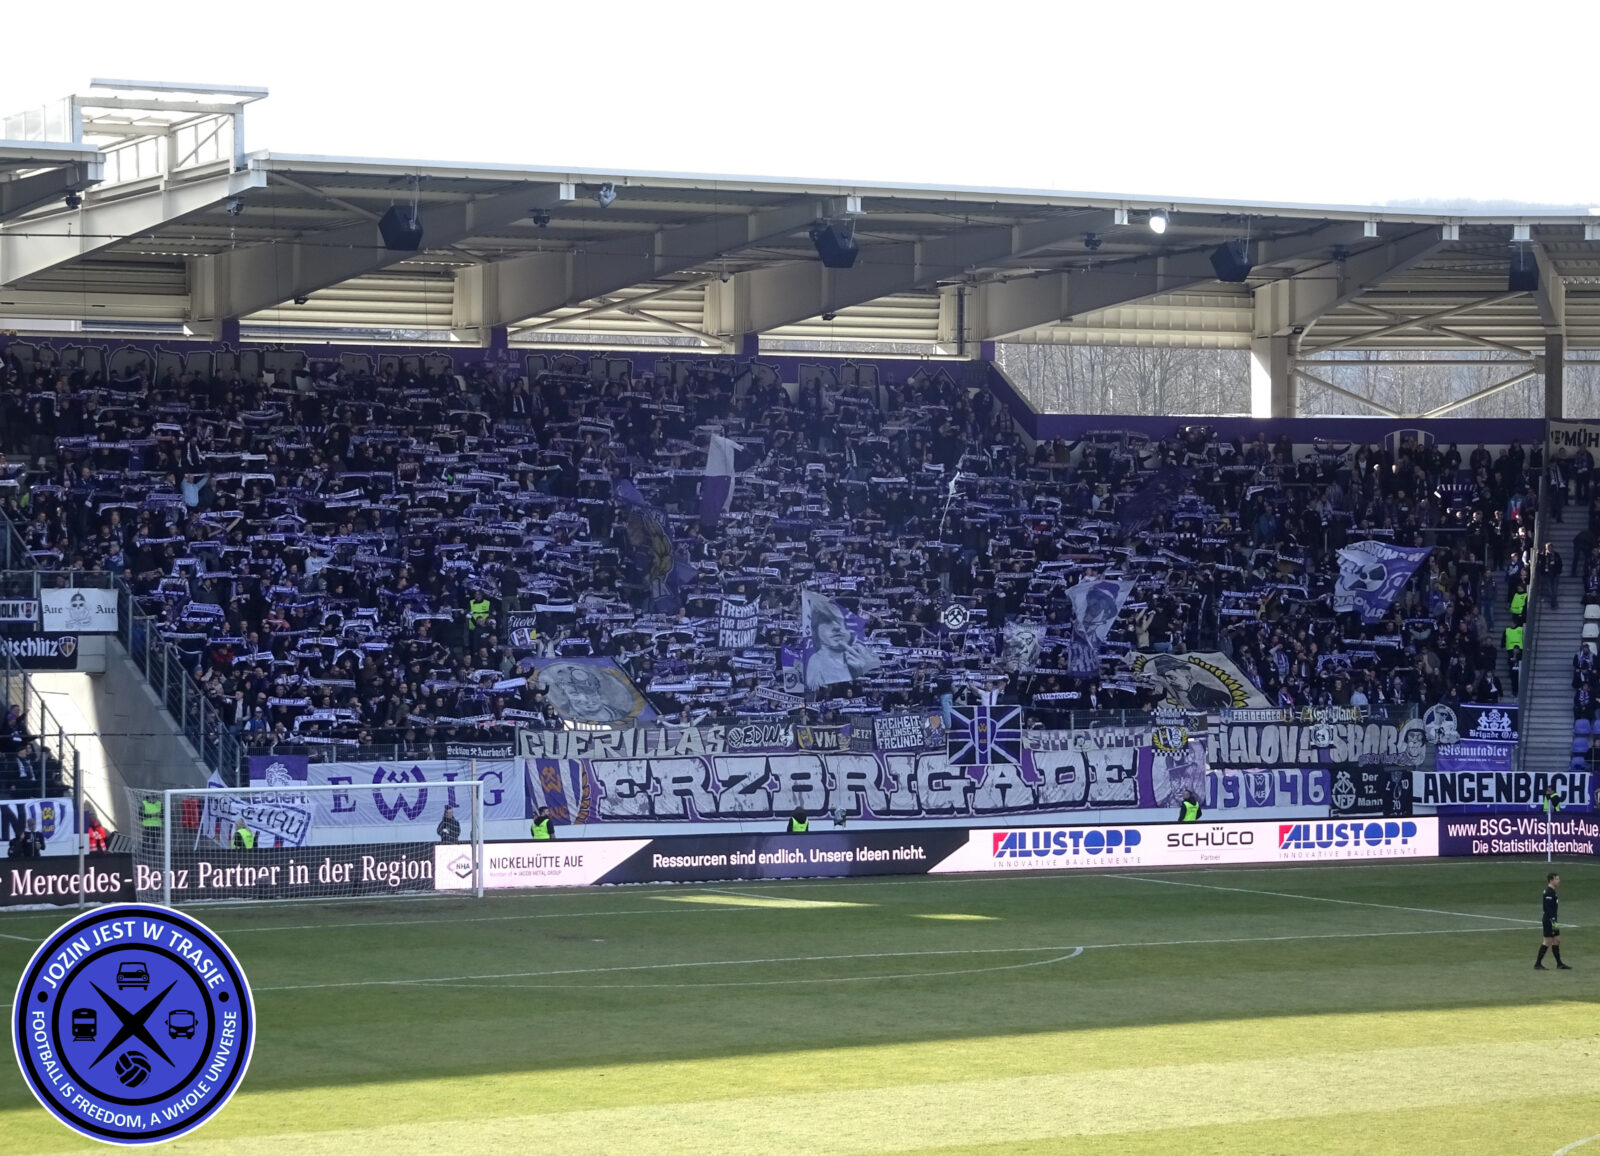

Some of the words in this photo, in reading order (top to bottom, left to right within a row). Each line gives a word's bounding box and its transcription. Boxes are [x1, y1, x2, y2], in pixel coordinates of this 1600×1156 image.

[876, 715, 920, 729] FREIHEIT
[893, 727, 922, 737] UNSERE
[1469, 729, 1498, 739] Brigade
[519, 726, 726, 760] GUERILLAS
[879, 735, 924, 750] FREUNDE
[1438, 744, 1508, 758] Wismutadler
[594, 747, 1139, 818] ERZBRIGADE
[1361, 772, 1380, 782] Der
[1364, 785, 1378, 795] 12.
[1357, 797, 1384, 807] Mann
[1167, 827, 1254, 847] SCHÜCO
[1280, 821, 1417, 850] ALUSTOPP
[994, 831, 1141, 858] ALUSTOPP
[1472, 839, 1490, 854] Die
[1491, 838, 1594, 854] Statistikdatenbank
[490, 853, 560, 869] NICKELHÜTTE
[563, 856, 584, 867] AUE
[653, 853, 727, 869] Ressourcen
[730, 851, 756, 866] sind
[758, 849, 806, 865] endlich.
[809, 848, 853, 863] Unsere
[855, 847, 889, 862] Ideen
[892, 845, 926, 860] nicht.
[1279, 850, 1347, 860] INNOVATIVE
[993, 858, 1062, 868] INNOVATIVE
[198, 859, 278, 890] Partner
[289, 857, 309, 884] in
[318, 856, 354, 884] der
[361, 853, 433, 888] Region
